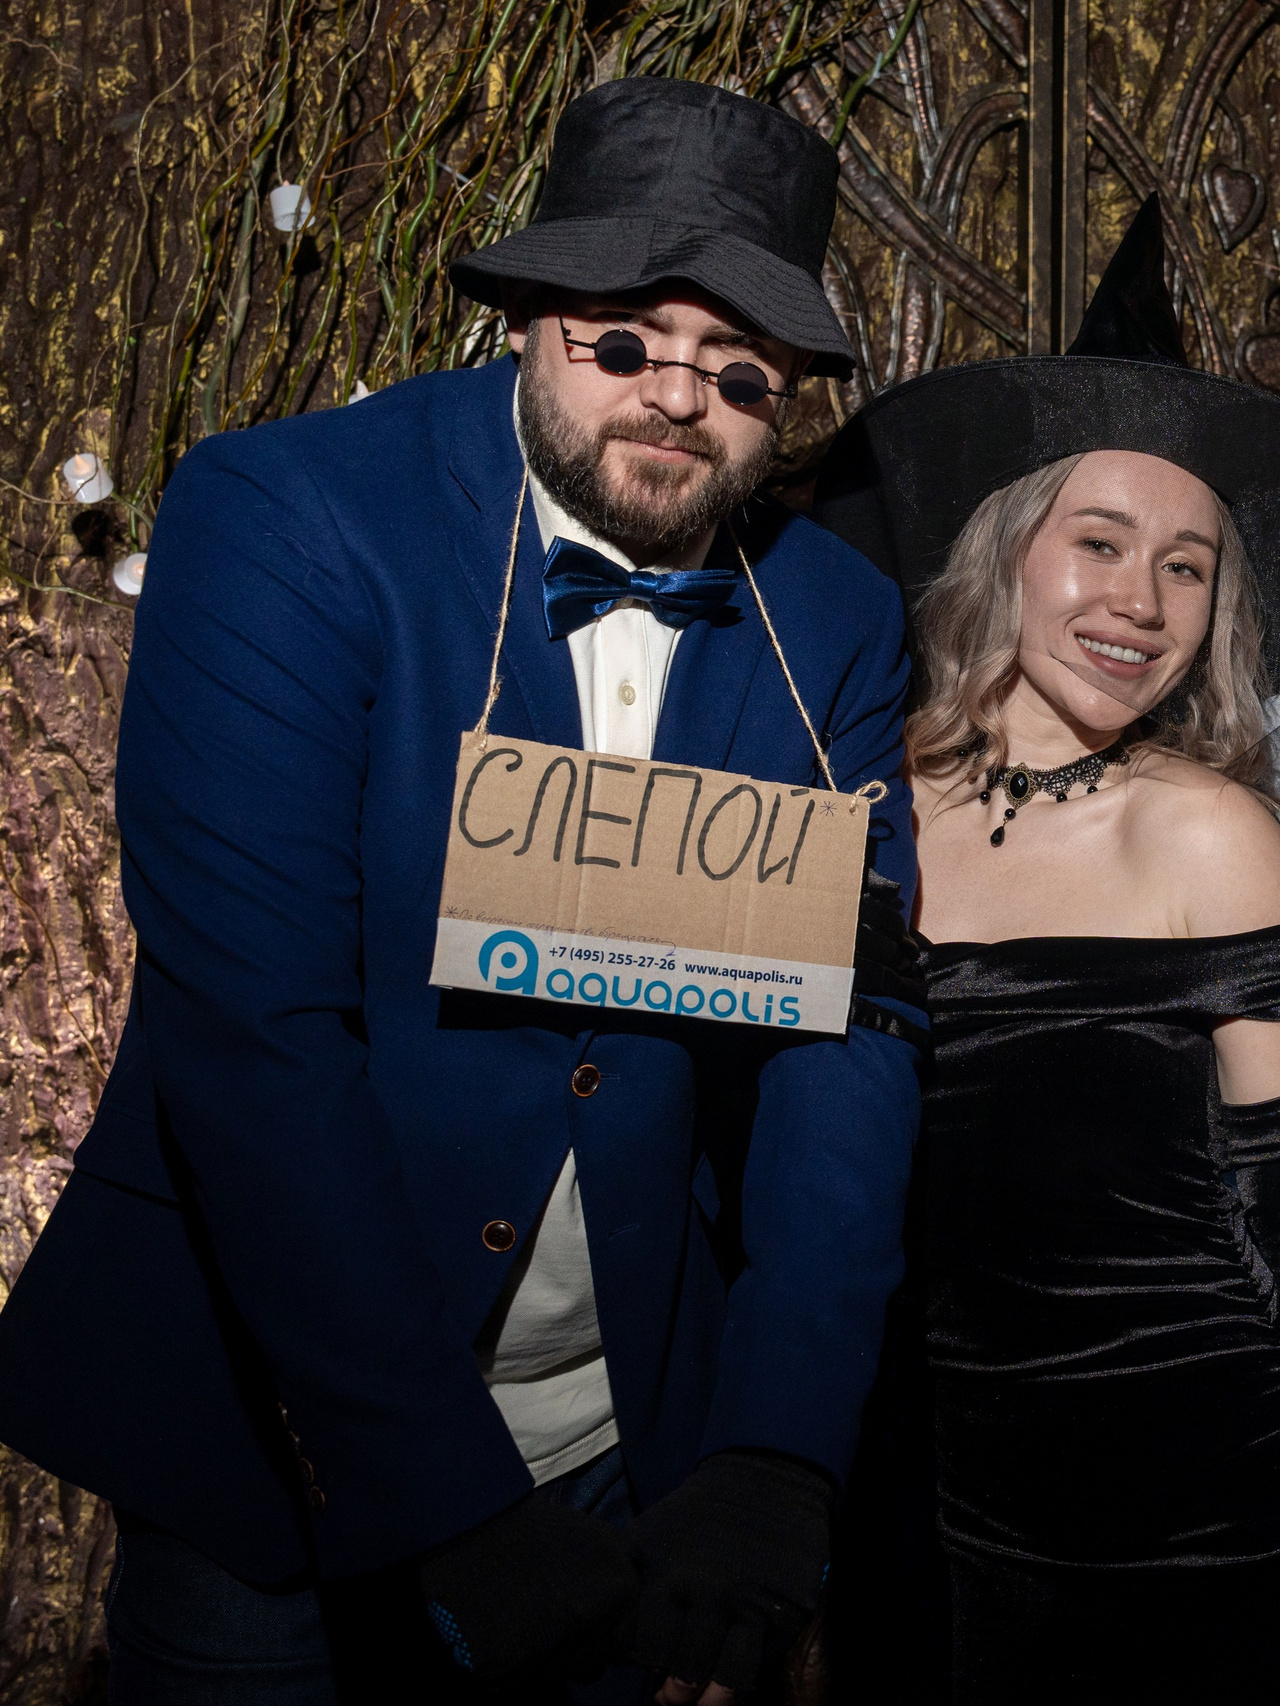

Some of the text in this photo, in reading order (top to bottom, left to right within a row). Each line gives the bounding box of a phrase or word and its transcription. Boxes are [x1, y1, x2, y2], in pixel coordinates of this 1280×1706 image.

[458, 748, 815, 885] СЛЕПОЙ
[549, 946, 803, 985] +7 (495) 255-27-26 www.aquapolis.ru
